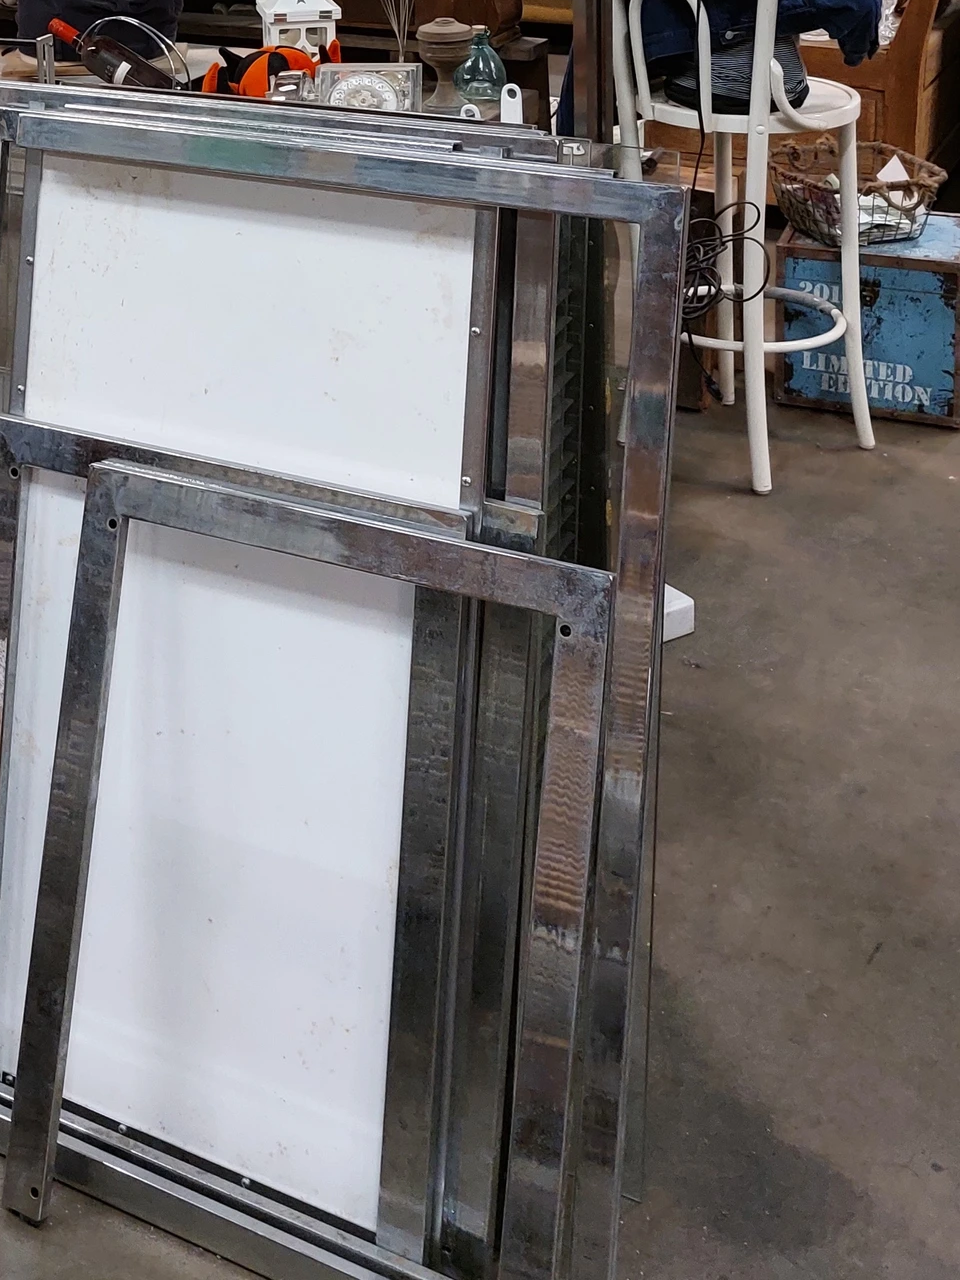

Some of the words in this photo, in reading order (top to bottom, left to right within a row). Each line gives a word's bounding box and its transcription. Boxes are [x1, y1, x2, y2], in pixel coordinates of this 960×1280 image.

[798, 280, 840, 304] 201
[801, 351, 914, 384] LIMTED
[820, 373, 933, 407] EDTION
